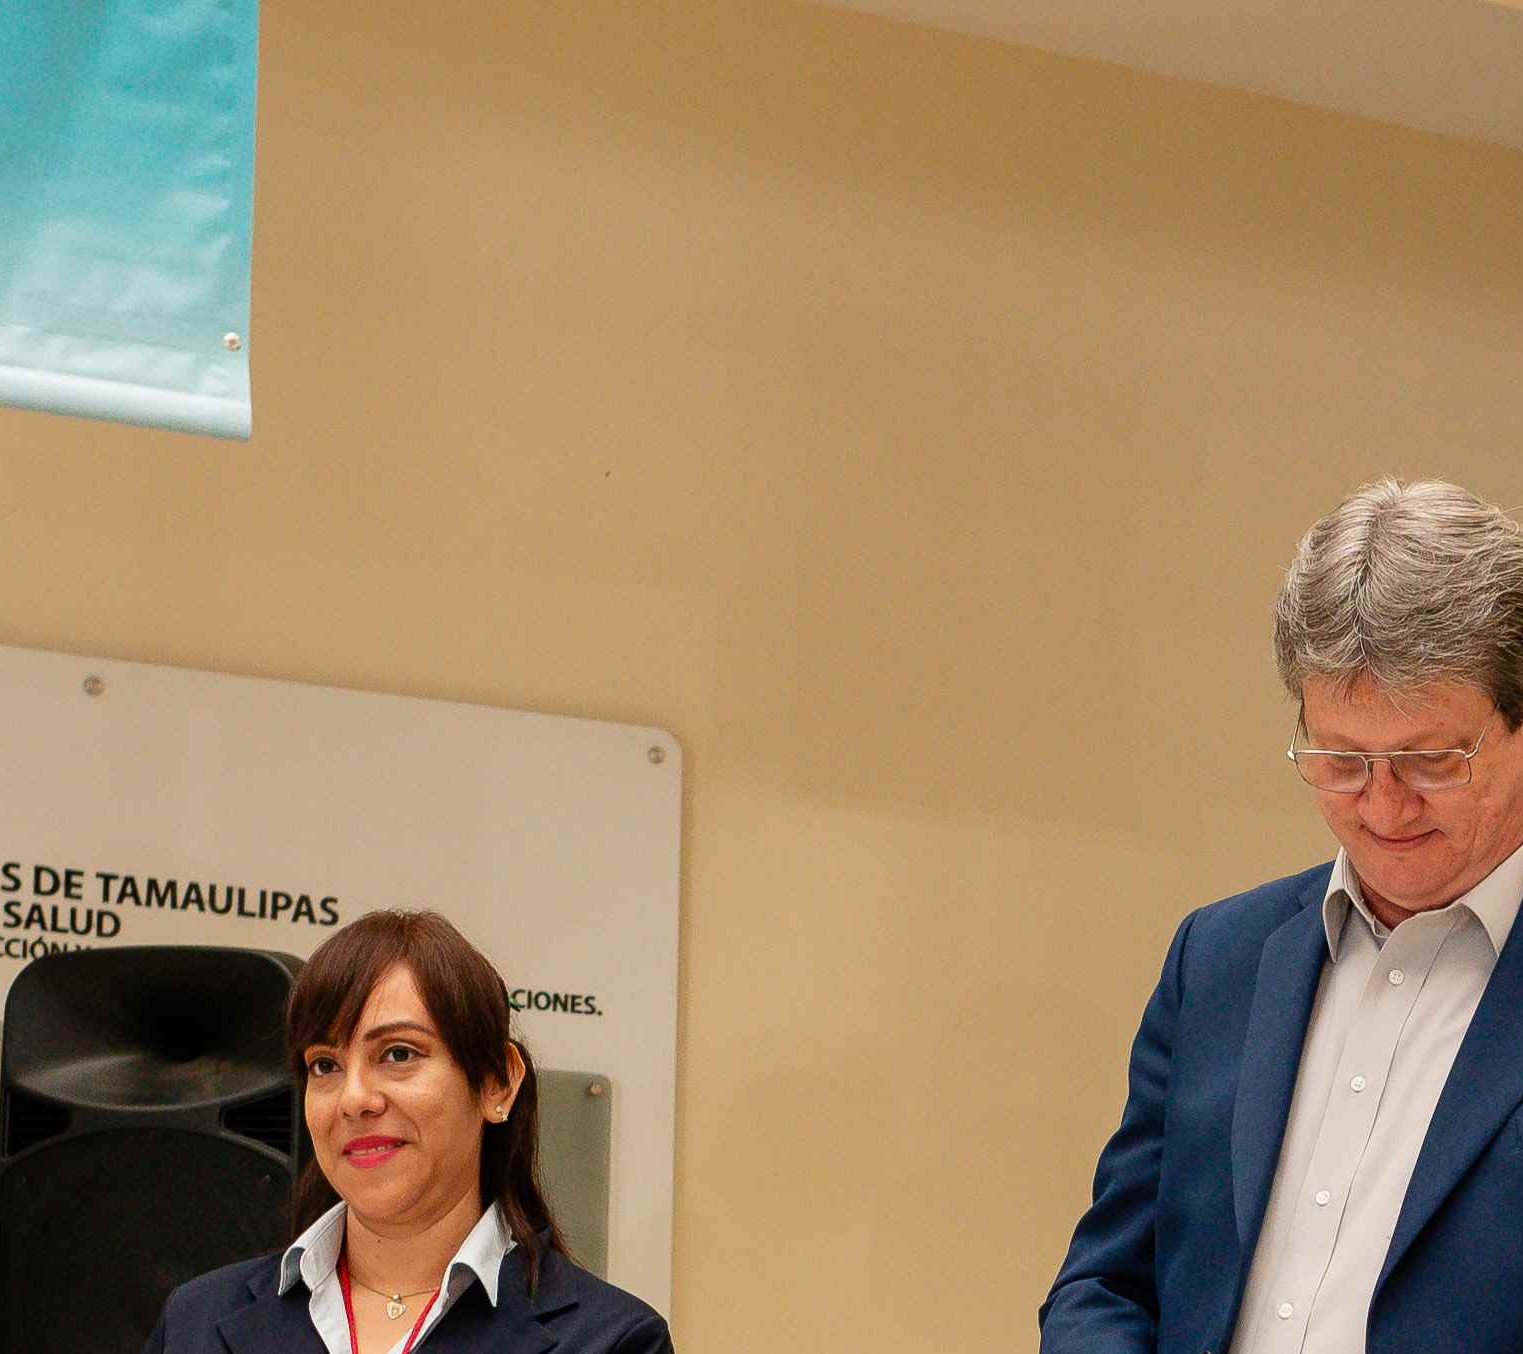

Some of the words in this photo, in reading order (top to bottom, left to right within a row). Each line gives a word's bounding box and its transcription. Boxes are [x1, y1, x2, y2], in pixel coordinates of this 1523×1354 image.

[33, 866, 84, 900] DE
[95, 872, 341, 927] TAMAULIPAS
[3, 899, 122, 938] SALUD
[511, 988, 603, 1016] CIONES.
